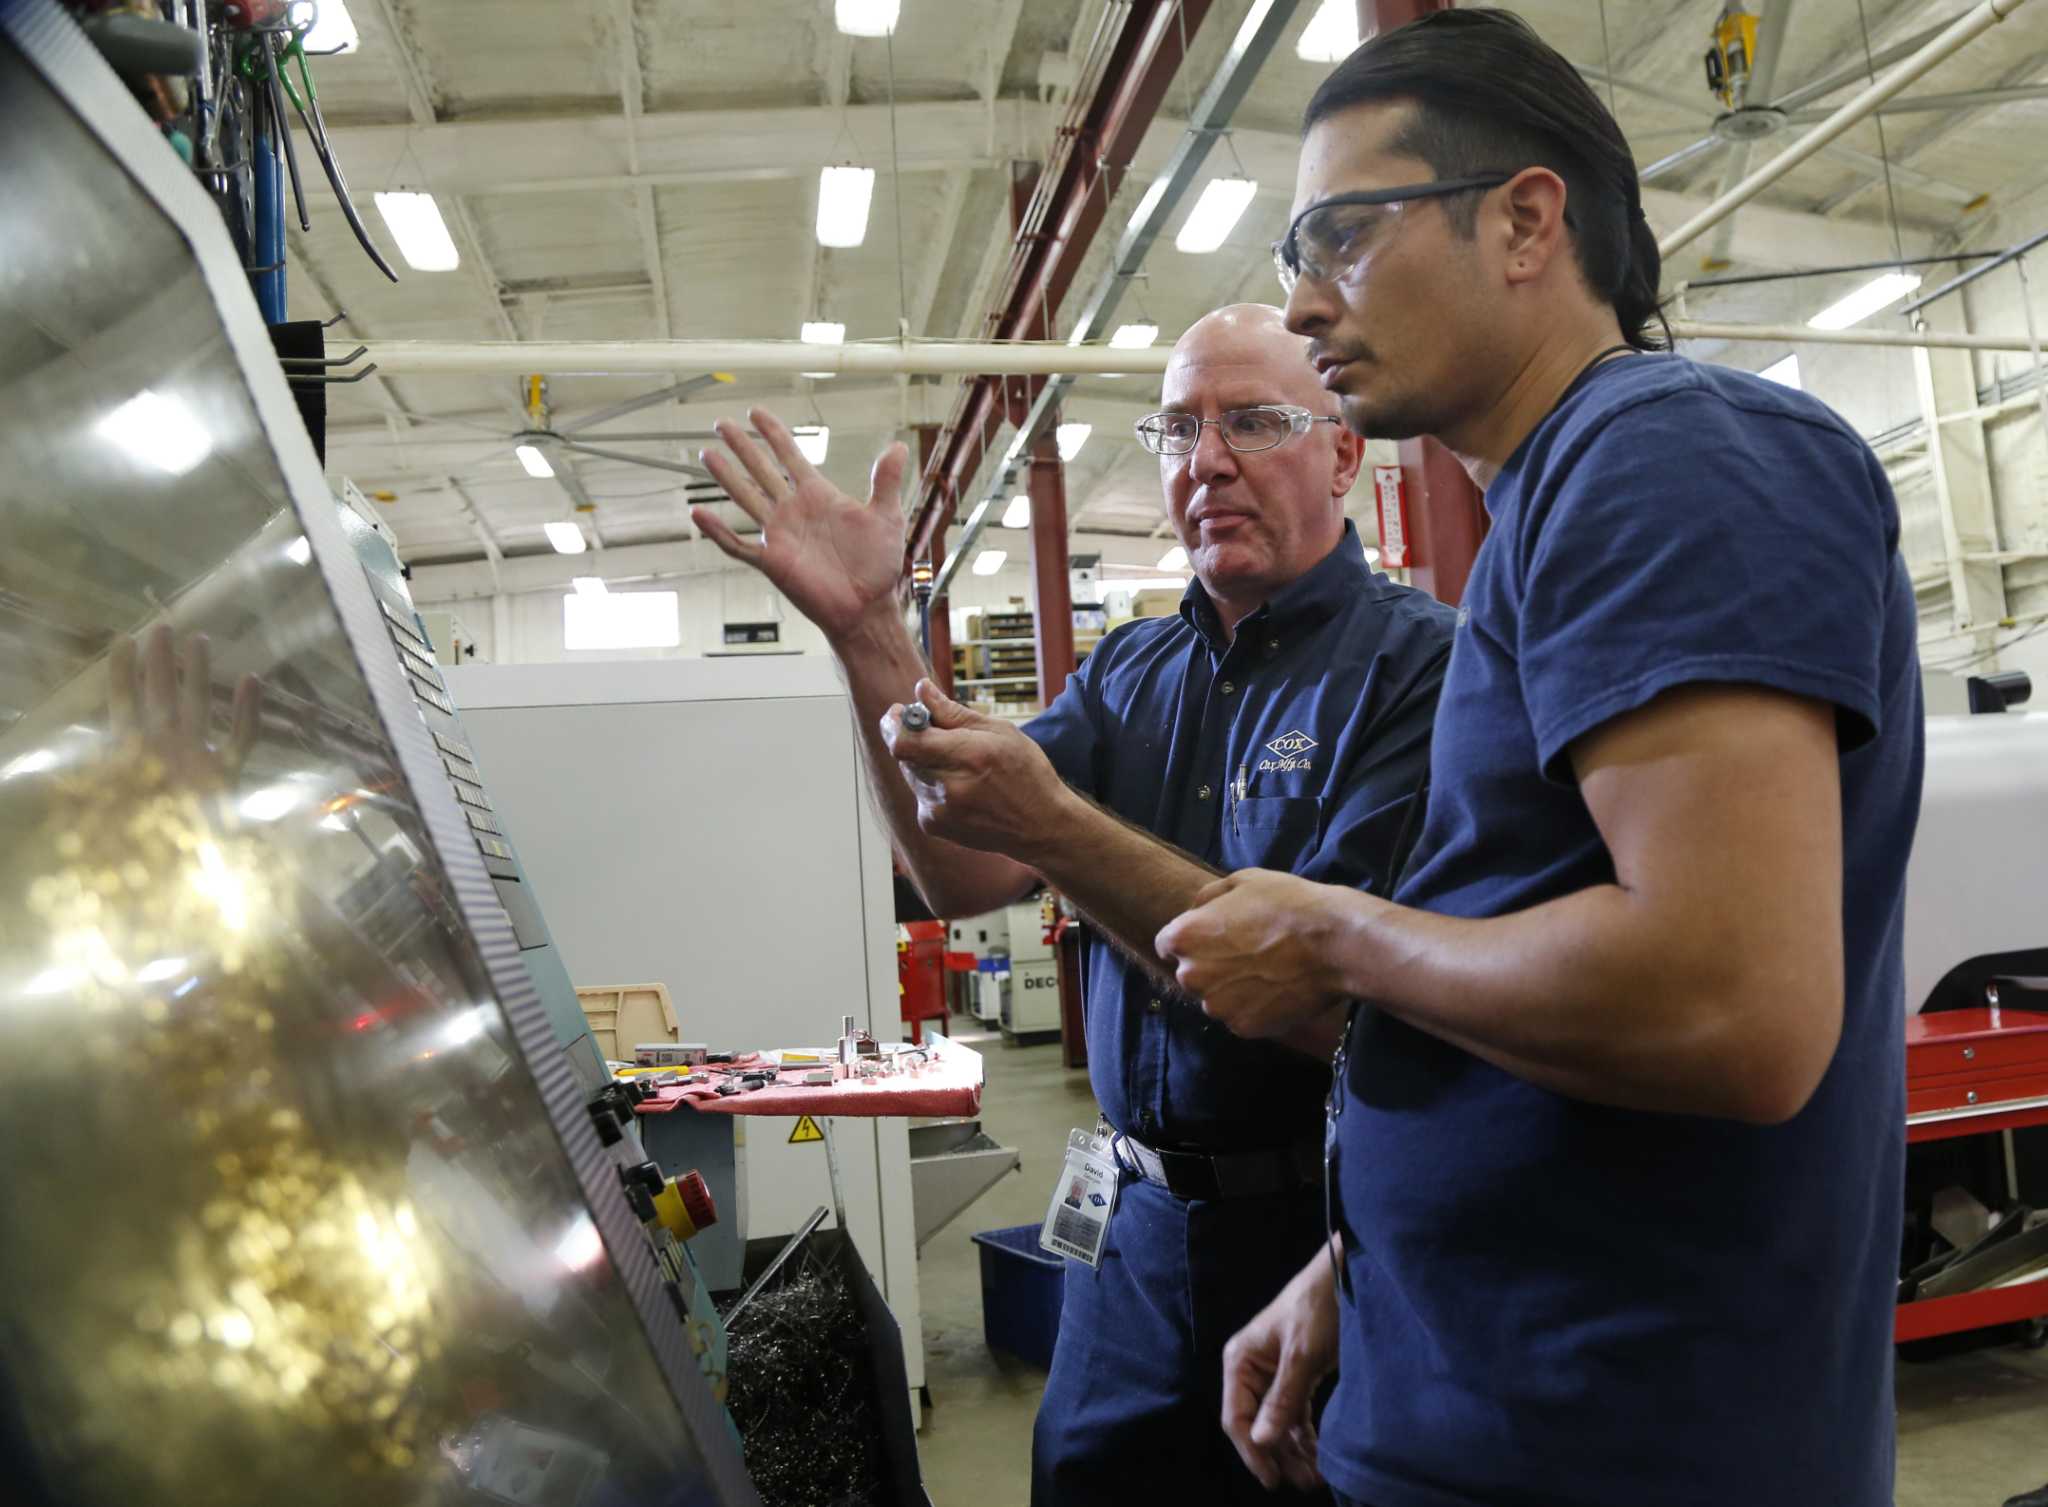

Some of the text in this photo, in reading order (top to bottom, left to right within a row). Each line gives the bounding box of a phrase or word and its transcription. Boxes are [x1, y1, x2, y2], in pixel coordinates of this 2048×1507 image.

[1274, 738, 1306, 750] COX
[1025, 976, 1060, 989] DEC
[1084, 1162, 1104, 1179] David
